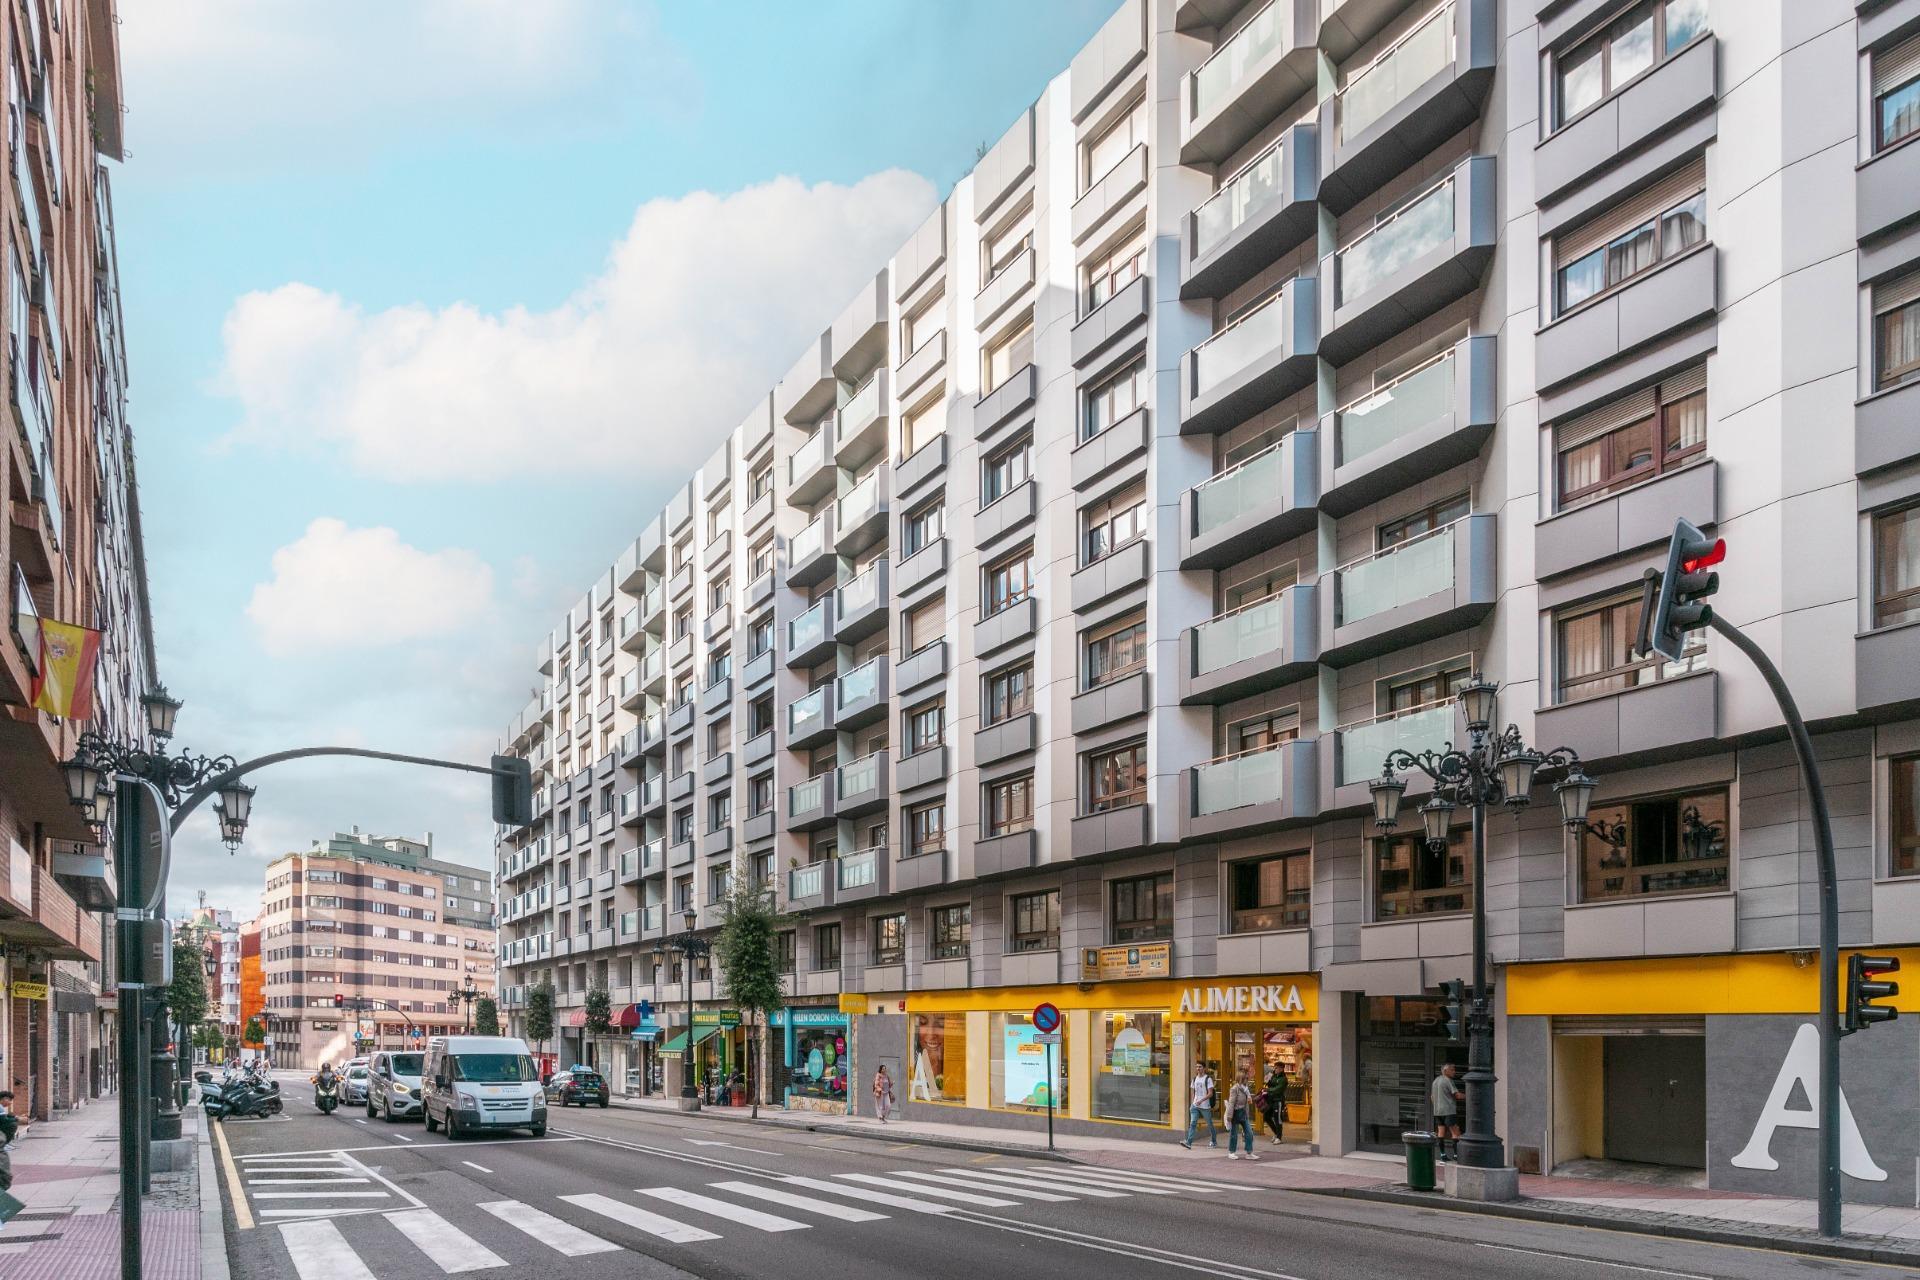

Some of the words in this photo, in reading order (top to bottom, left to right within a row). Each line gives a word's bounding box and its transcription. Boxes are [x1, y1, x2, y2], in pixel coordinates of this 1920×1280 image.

[1179, 984, 1305, 1013] ALIMERKA
[792, 1013, 808, 1022] HELEN
[809, 1013, 830, 1022] DORON
[1731, 1023, 1888, 1181] A
